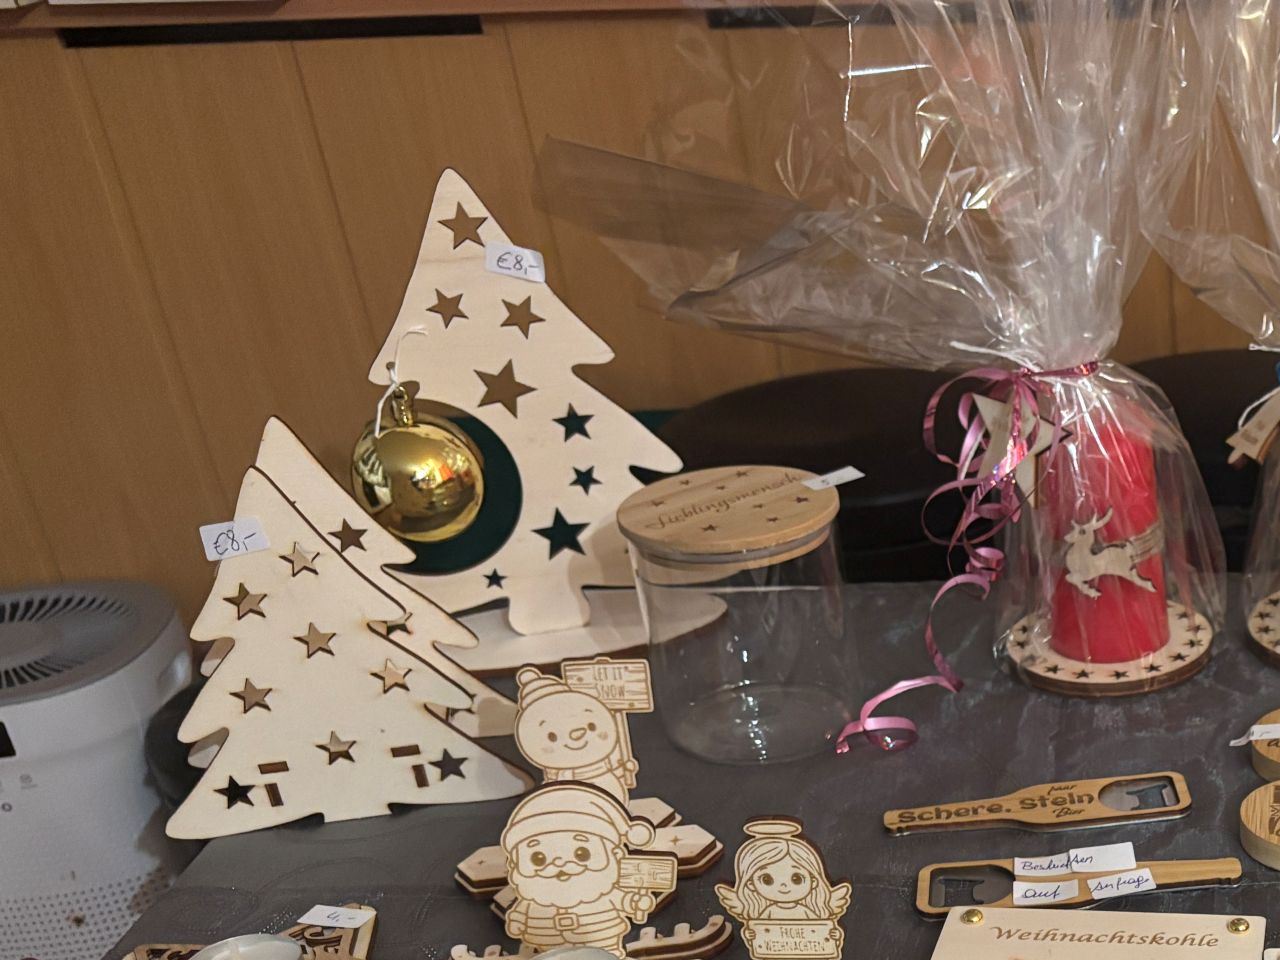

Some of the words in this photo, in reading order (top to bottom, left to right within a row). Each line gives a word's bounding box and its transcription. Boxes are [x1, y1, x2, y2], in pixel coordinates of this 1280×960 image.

[496, 251, 540, 276] €8,-
[212, 528, 257, 556] €8,-
[592, 665, 611, 682] LET
[595, 684, 626, 699] SNOW
[989, 925, 1219, 949] Weihnachtskohle
